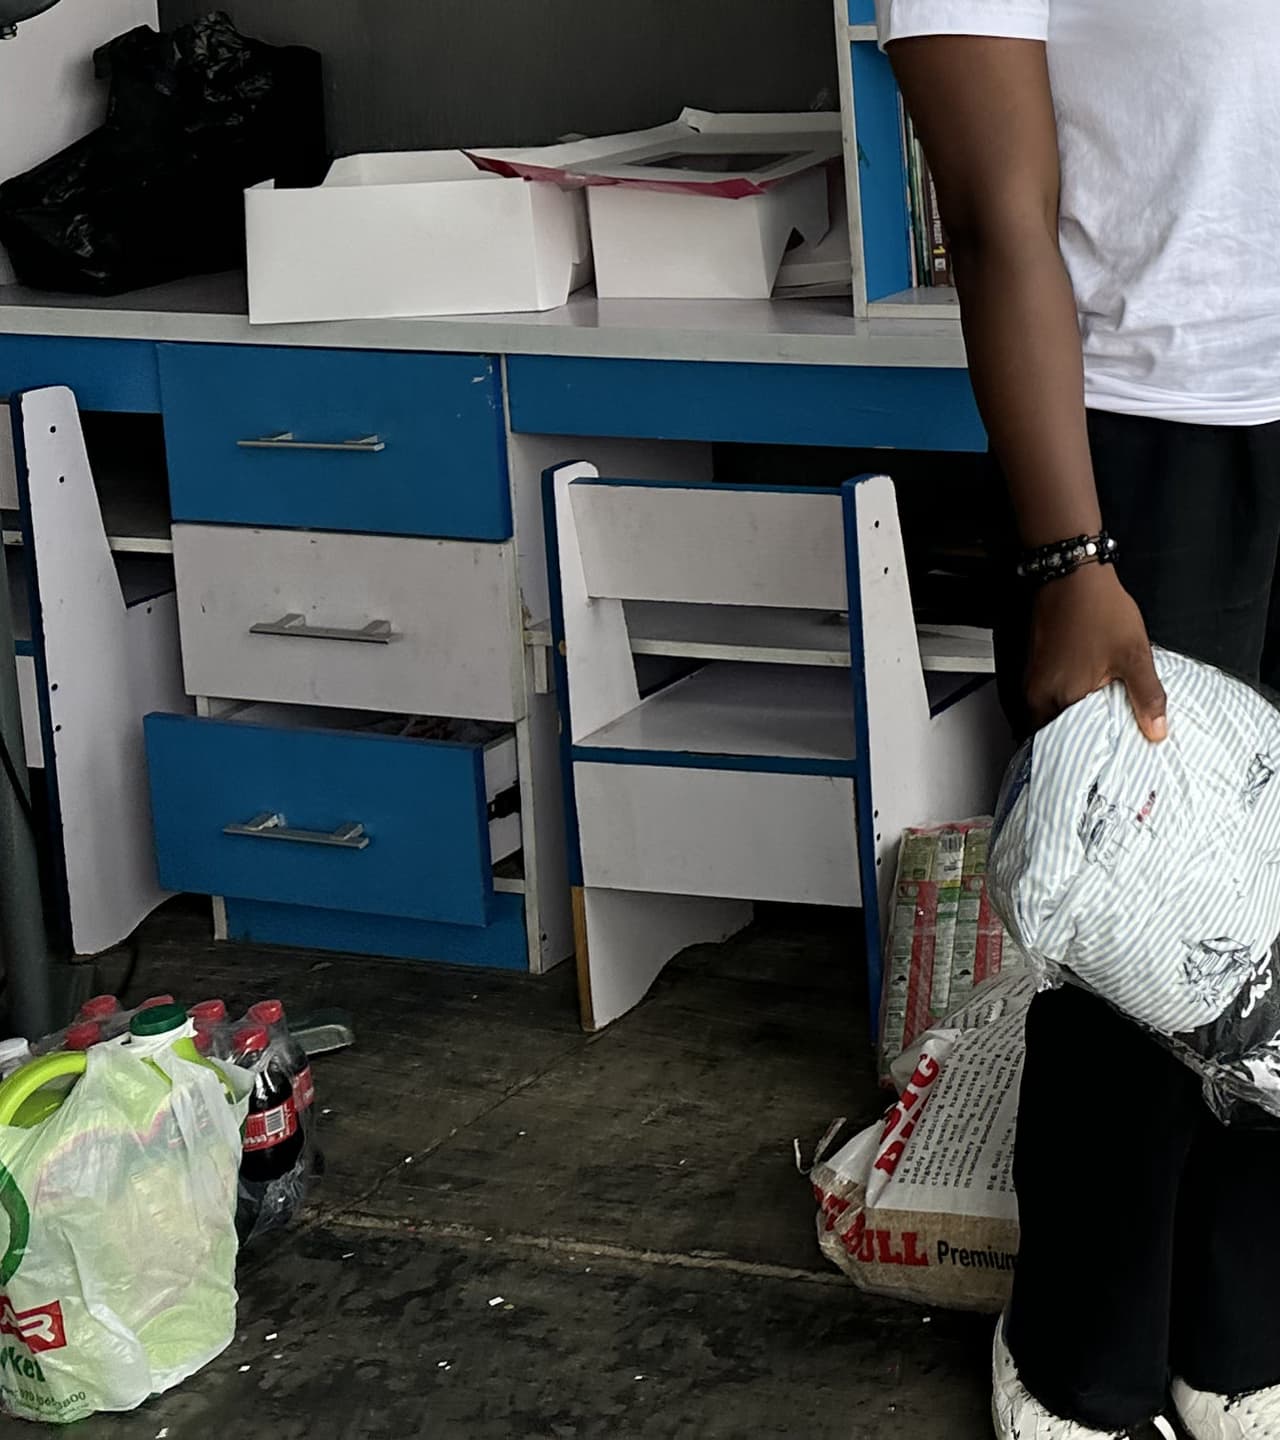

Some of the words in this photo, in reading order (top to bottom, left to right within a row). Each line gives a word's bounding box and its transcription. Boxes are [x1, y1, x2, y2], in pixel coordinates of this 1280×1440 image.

[922, 1103, 945, 1151] producing
[941, 1065, 960, 1101] regions
[934, 1111, 954, 1147] quality
[948, 1068, 969, 1109] harvests
[952, 1140, 976, 1189] machinery
[991, 1065, 1007, 1090] every
[956, 1069, 981, 1120] processed
